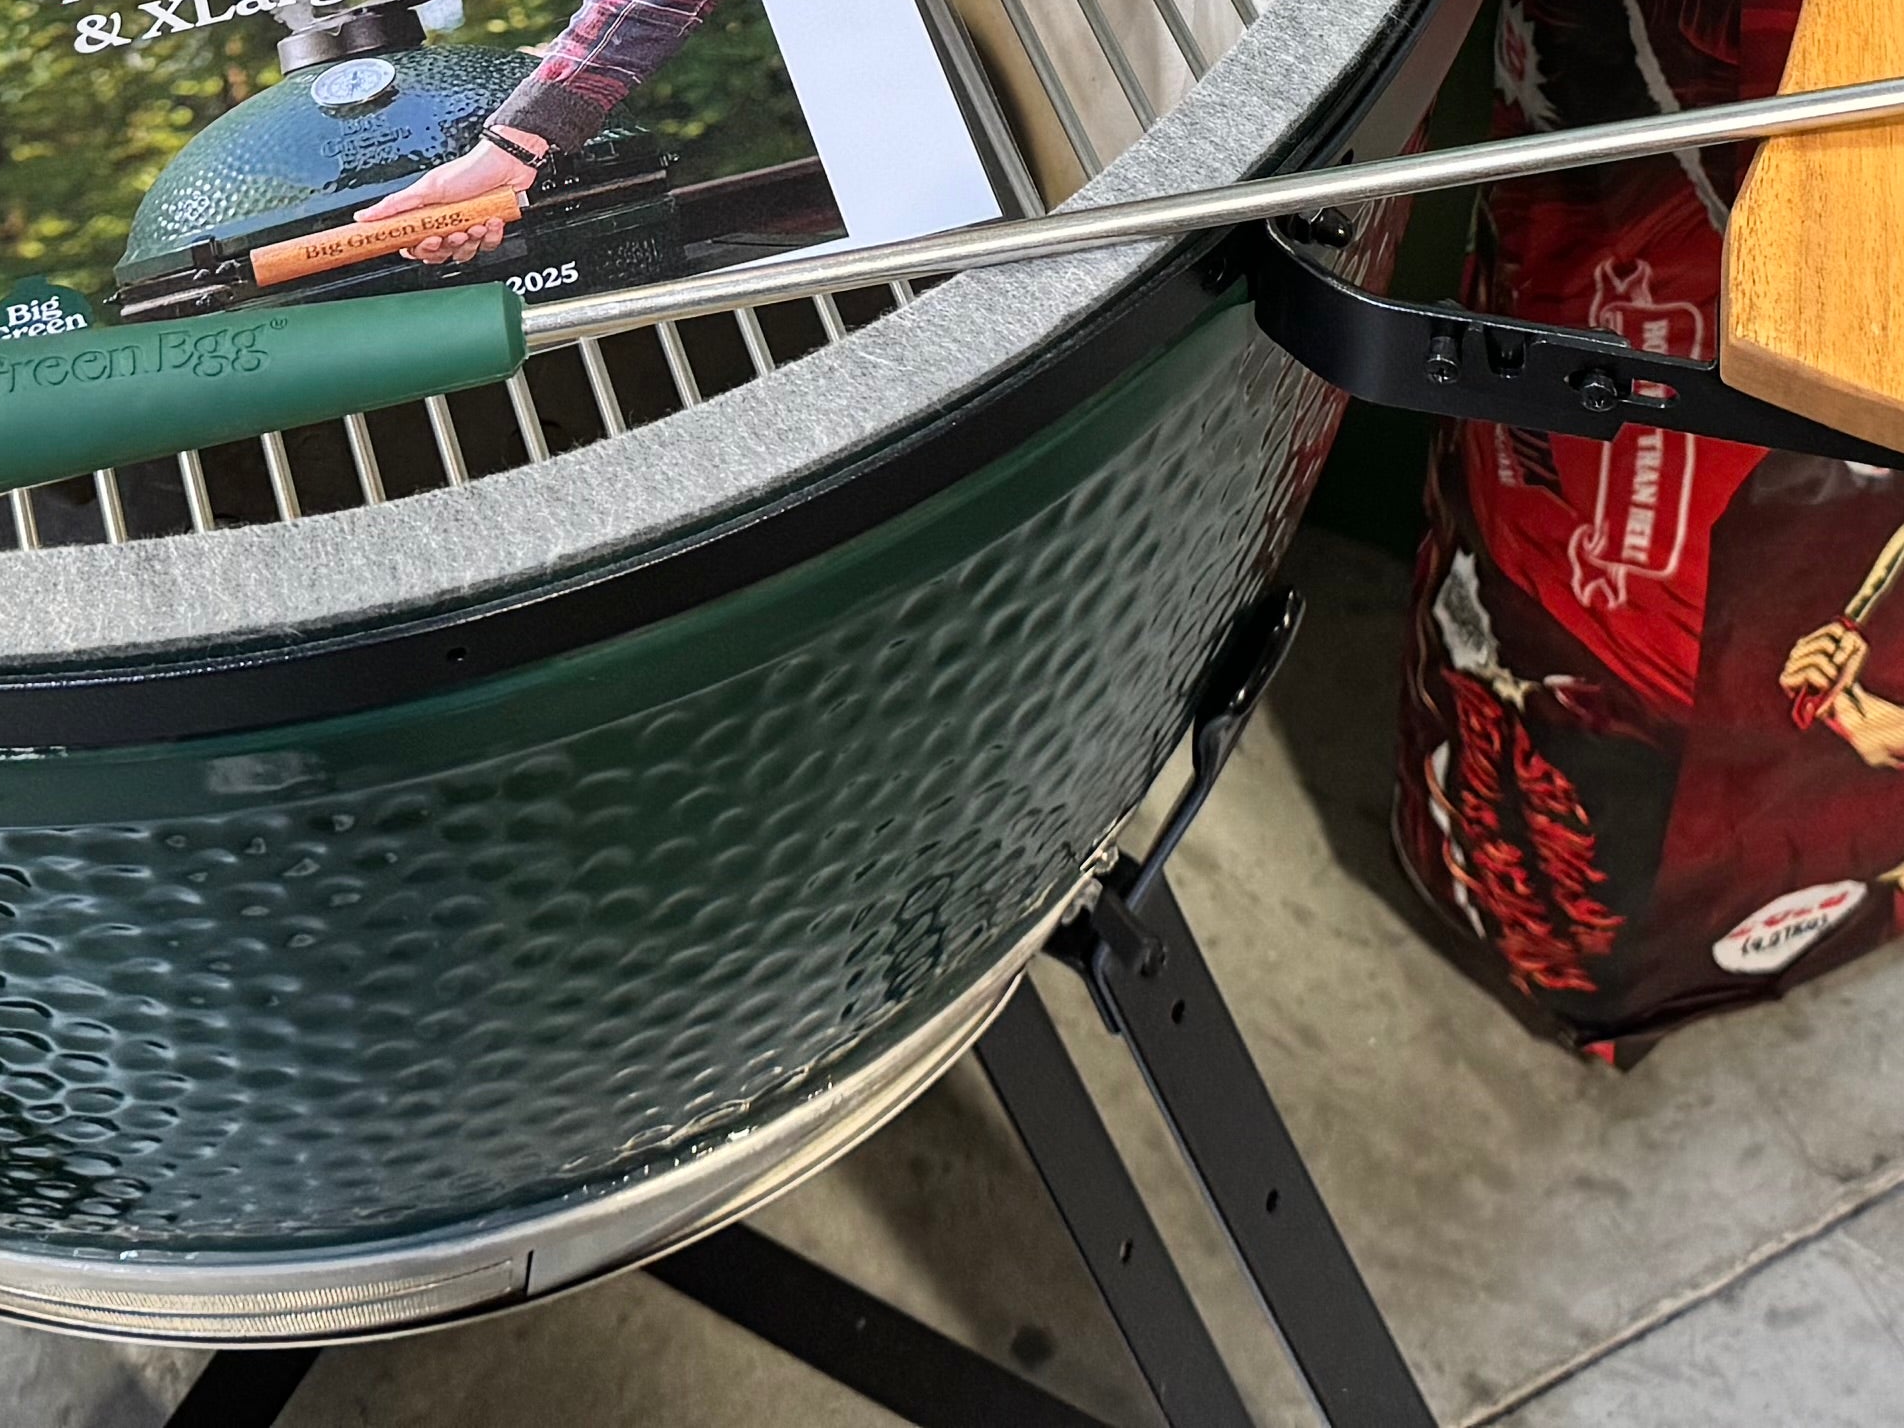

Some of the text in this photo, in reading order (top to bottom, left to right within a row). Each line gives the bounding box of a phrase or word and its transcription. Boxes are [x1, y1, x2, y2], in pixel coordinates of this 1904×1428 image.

[73, 11, 134, 55] &
[303, 239, 344, 261] Big
[347, 222, 418, 249] Green
[506, 260, 580, 295] 2025
[6, 295, 63, 328] Big
